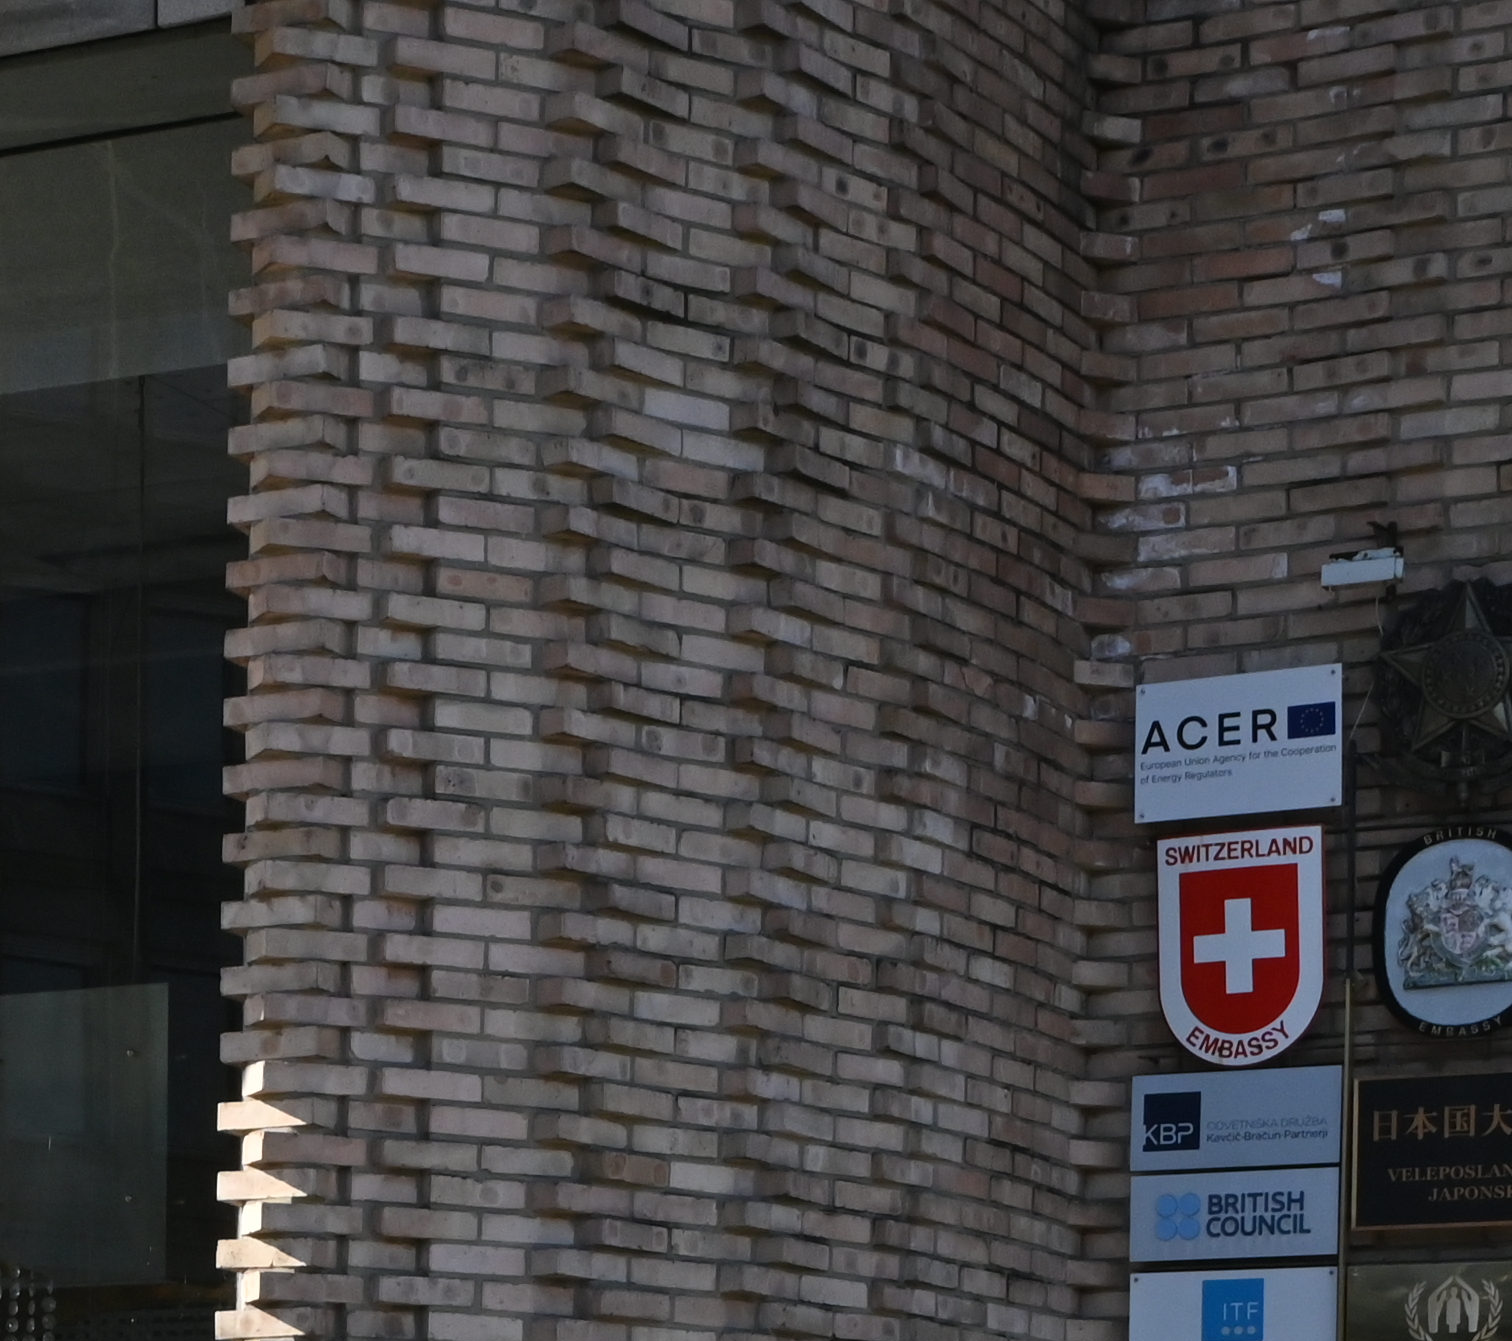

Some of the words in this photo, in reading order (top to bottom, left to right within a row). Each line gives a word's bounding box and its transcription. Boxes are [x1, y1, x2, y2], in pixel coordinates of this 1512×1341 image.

[1141, 708, 1278, 755] ACER
[1140, 759, 1182, 771] European
[1184, 756, 1211, 767] Union
[1213, 753, 1246, 767] Agency
[1249, 751, 1261, 761] for
[1263, 749, 1279, 759] the
[1281, 743, 1337, 758] Cooperation
[1140, 775, 1149, 785] of
[1151, 772, 1182, 785] Energy
[1184, 767, 1233, 782] Regulators
[1423, 826, 1497, 846] BRITISH
[1165, 836, 1314, 866] SWITZERLAND
[1417, 1015, 1505, 1037] EMBASSY
[1185, 1020, 1290, 1060] EMBASSY
[1142, 1121, 1194, 1146] KBP
[1207, 1190, 1305, 1216] BRITISH
[1205, 1213, 1311, 1238] COUNCIL
[1222, 1301, 1259, 1321] ITF
